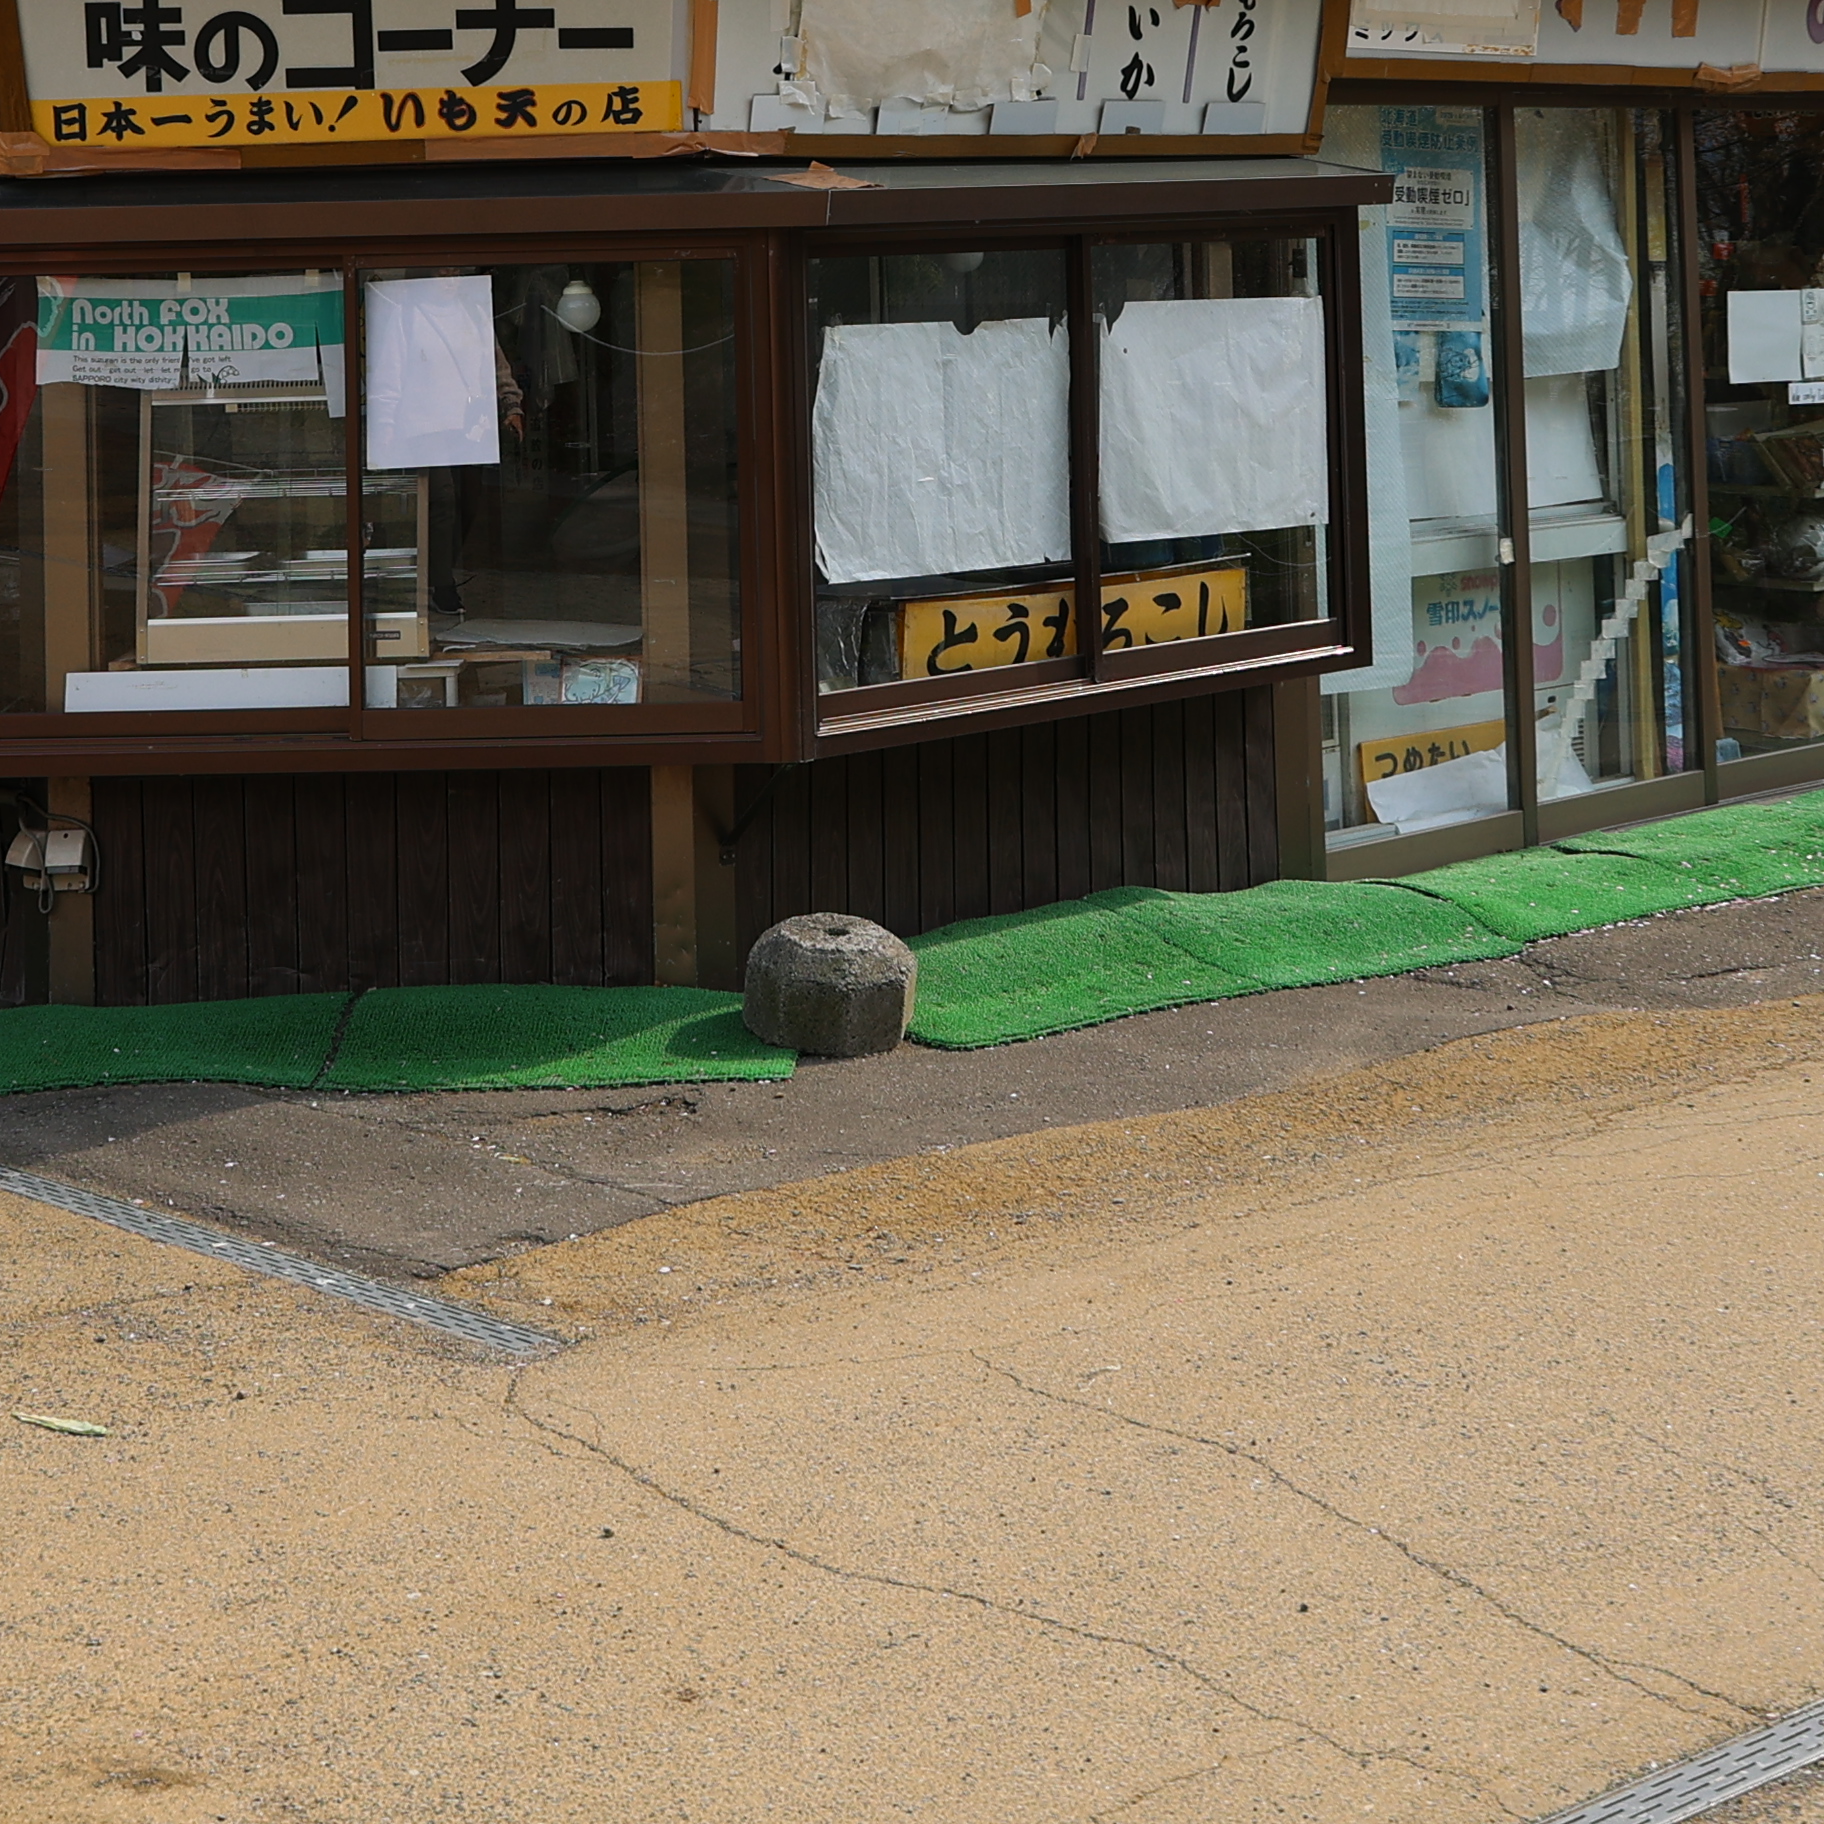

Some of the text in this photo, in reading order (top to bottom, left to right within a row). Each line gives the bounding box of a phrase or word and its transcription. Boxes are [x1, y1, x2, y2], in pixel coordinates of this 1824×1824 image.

[72, 298, 229, 325] North FOX
[72, 322, 294, 351] in HOKKAIDO
[72, 375, 111, 383] SAPPORO
